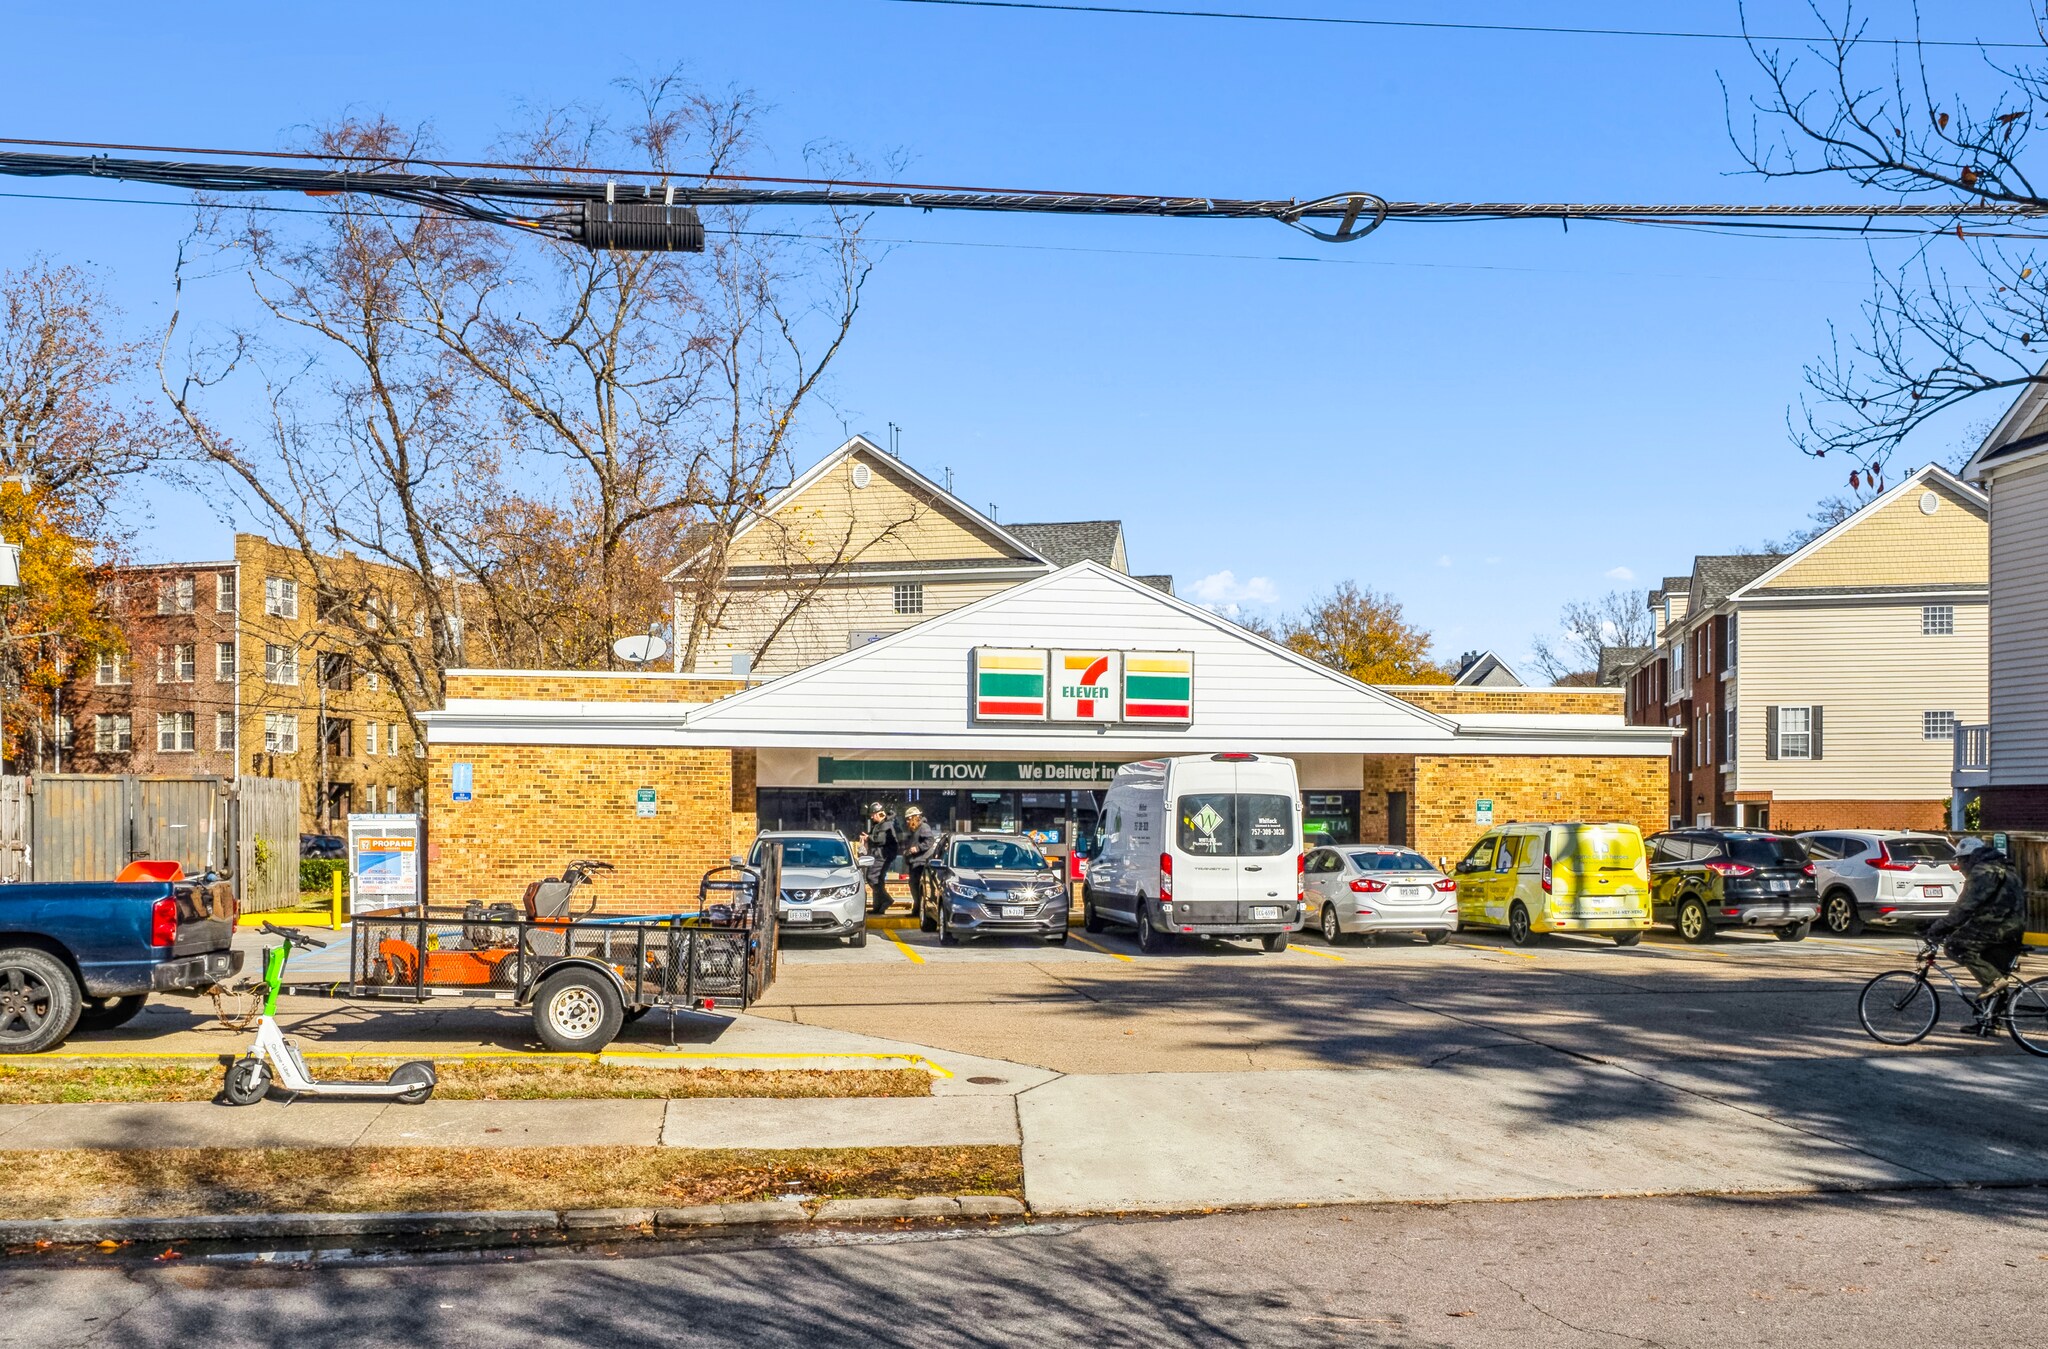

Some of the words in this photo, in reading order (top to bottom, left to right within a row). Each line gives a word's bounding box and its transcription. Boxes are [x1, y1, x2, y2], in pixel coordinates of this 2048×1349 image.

[1064, 655, 1108, 717] 7
[1018, 764, 1043, 779] We
[1045, 764, 1099, 779] Deliver
[1101, 764, 1116, 779] in
[1199, 813, 1218, 829] W
[1321, 820, 1348, 831] ATM
